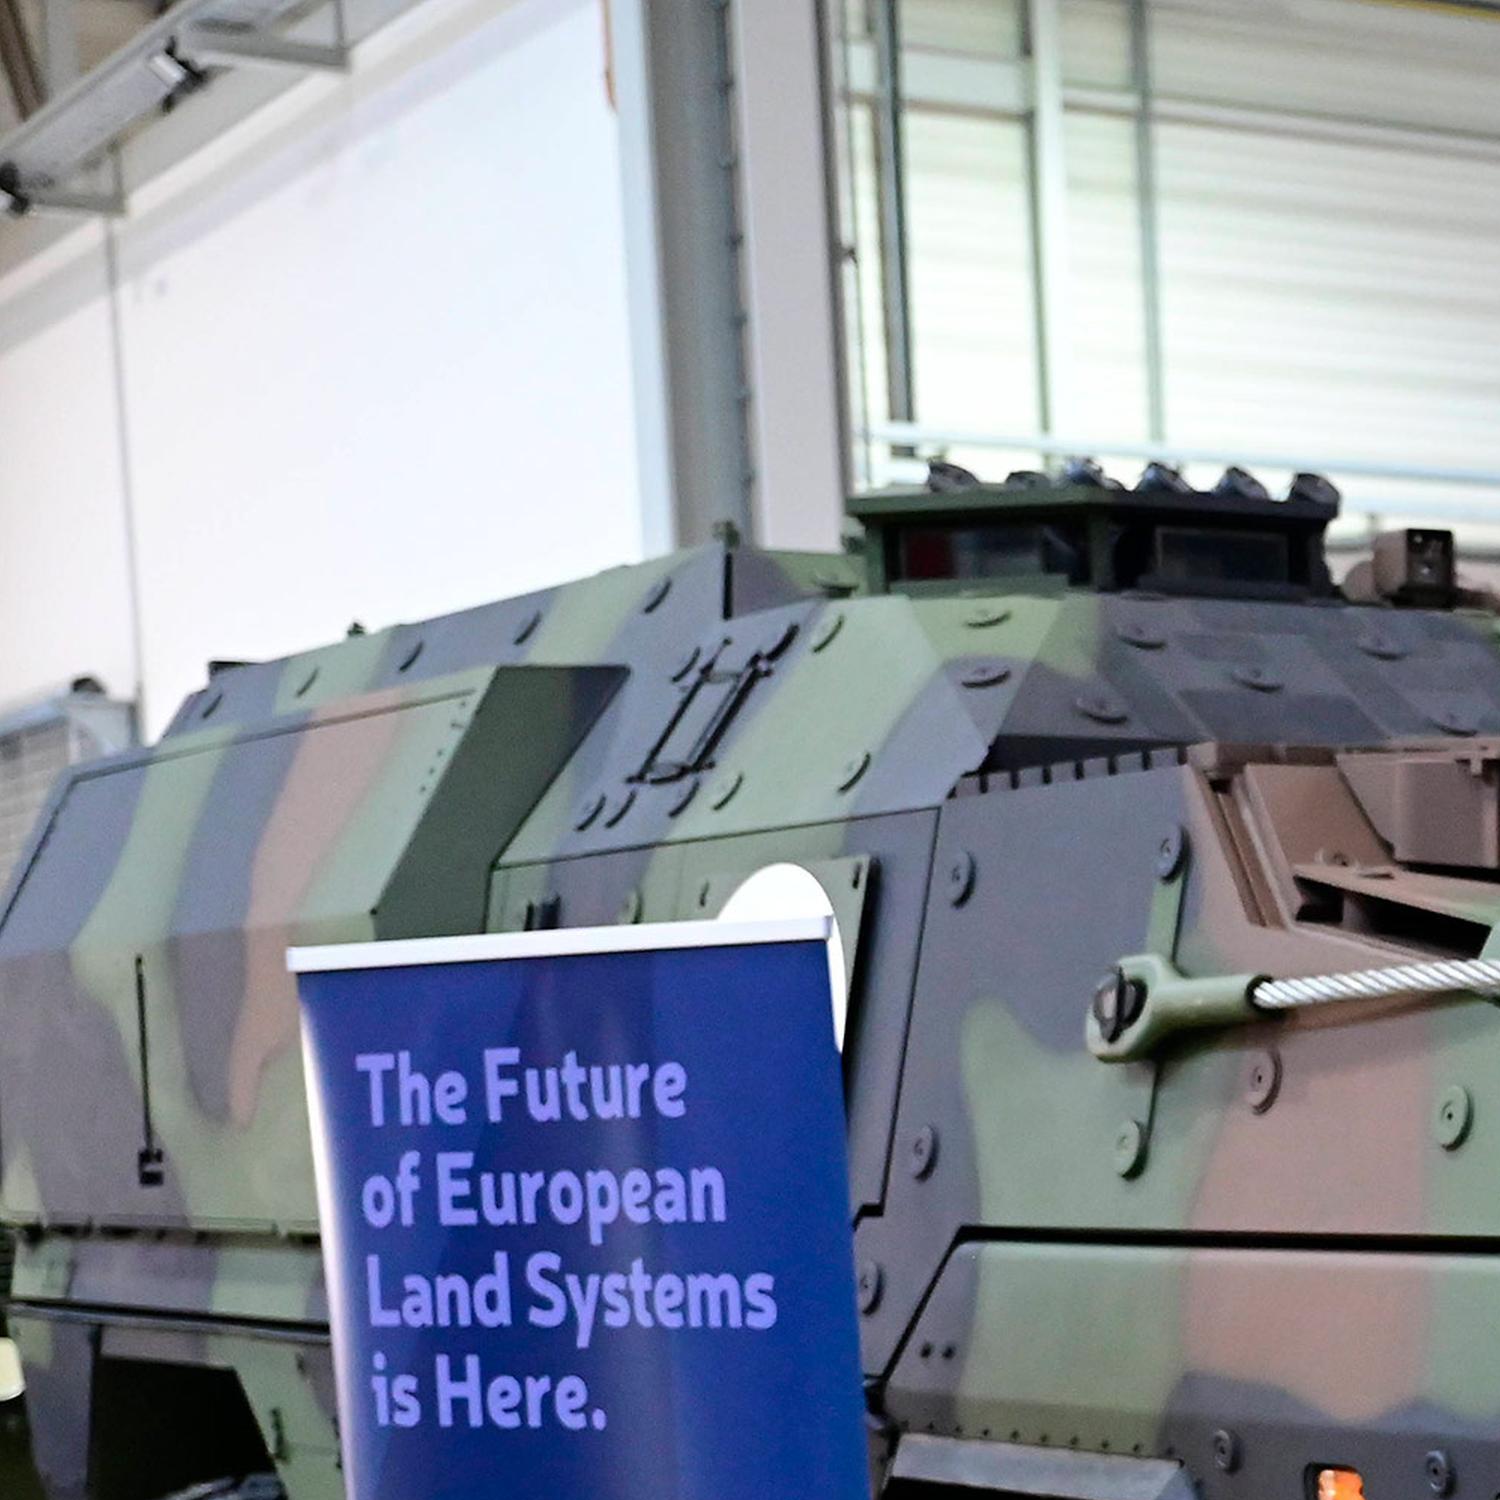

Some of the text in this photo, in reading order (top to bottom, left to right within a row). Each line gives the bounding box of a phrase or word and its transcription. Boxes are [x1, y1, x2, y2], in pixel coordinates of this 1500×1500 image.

[356, 1047, 687, 1127] The Future
[362, 1150, 726, 1245] of European
[366, 1251, 778, 1348] Land Systems
[370, 1352, 608, 1431] is Here.
